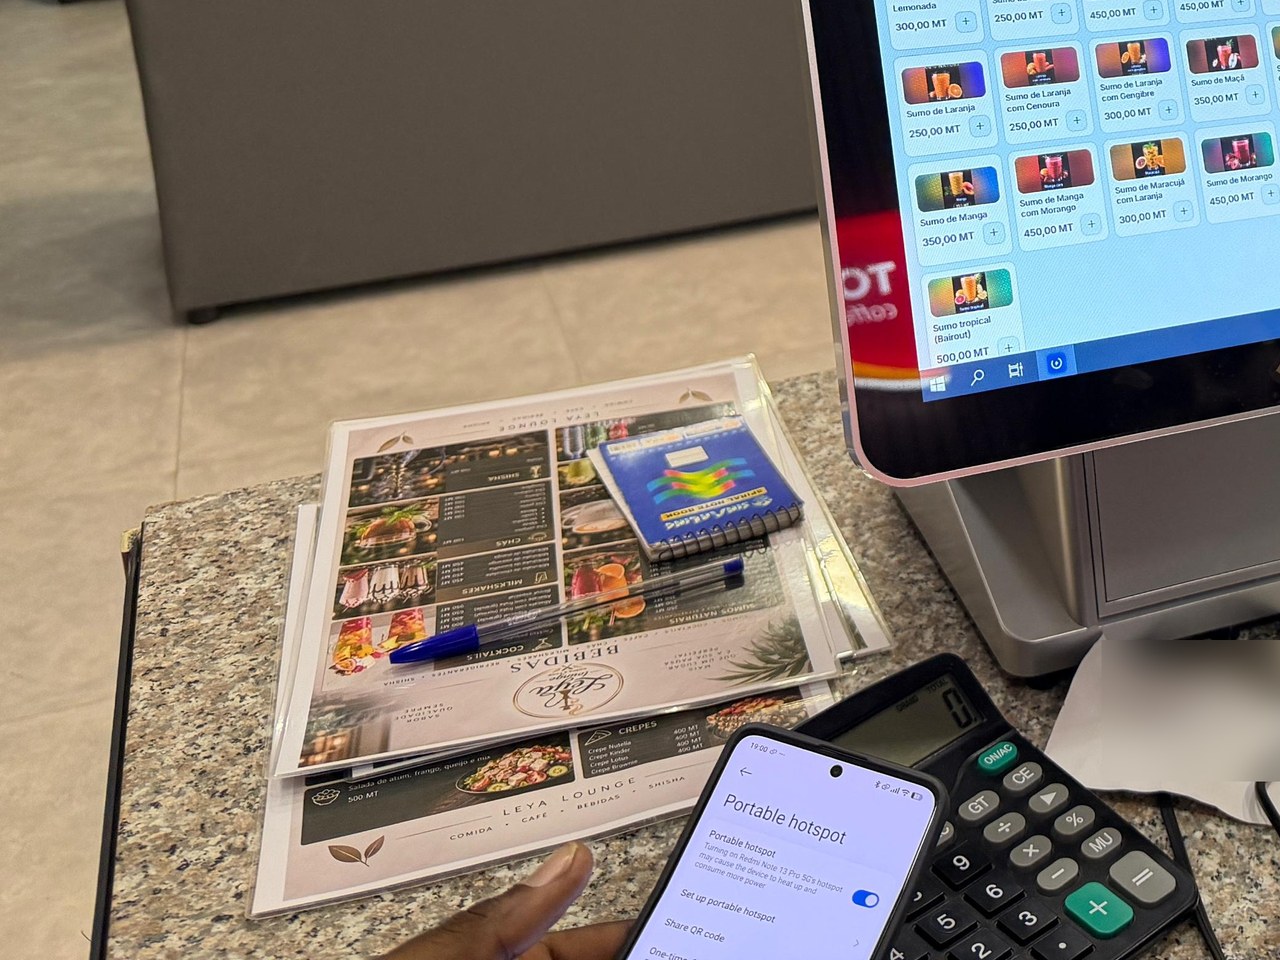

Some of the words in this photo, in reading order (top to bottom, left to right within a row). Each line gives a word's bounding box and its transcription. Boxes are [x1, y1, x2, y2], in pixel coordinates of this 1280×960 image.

[893, 2, 937, 12] Lemonada
[1180, 2, 1209, 11] 450,00
[1211, 0, 1224, 8] MT
[994, 13, 1027, 23] 250,00
[1029, 11, 1043, 20] MT
[896, 21, 930, 32] 300,00
[932, 19, 947, 28] MT
[1191, 79, 1213, 87] Sumo
[1225, 74, 1245, 84] Maçã
[1194, 95, 1224, 106] 350,00
[1225, 93, 1239, 101] MT
[1115, 185, 1138, 194] Sumo
[1149, 178, 1185, 190] Maracujá
[1116, 196, 1134, 204] com
[1134, 192, 1163, 202] Laranja
[1119, 212, 1151, 224] 300,00
[1152, 210, 1167, 220] MT
[933, 322, 957, 332] Sumo
[960, 316, 991, 330] tropical
[934, 330, 971, 344] (Bairout)
[936, 350, 972, 364] 500,00
[973, 347, 989, 357] MT
[462, 579, 522, 594] MILKSHAKES
[669, 611, 717, 624] NATURAIS
[466, 644, 524, 660] COCKTAILS
[510, 645, 618, 673] BEBIDAS
[529, 674, 613, 696] Leya
[619, 721, 658, 735] CREPES
[750, 742, 768, 753] 19:00
[984, 743, 1013, 765] ON/AC
[648, 776, 685, 789] SHISHA
[1012, 768, 1035, 784] CE
[348, 794, 363, 803] 500
[365, 791, 379, 800] MT
[503, 799, 548, 816] LEYA
[562, 776, 637, 802] LOUNGE
[968, 797, 990, 814] GT
[450, 826, 493, 840] COMIDA
[577, 794, 621, 810] BEBIDAS
[723, 794, 786, 825] Portable
[788, 814, 846, 845] hotspot
[709, 830, 743, 847] Portable
[744, 841, 776, 858] hotspot
[1089, 833, 1113, 852] MU
[704, 842, 728, 858] Turning
[739, 853, 760, 866] Redmi
[762, 861, 777, 871] Note
[789, 869, 801, 879] Pro
[817, 878, 843, 893] hotspot
[953, 855, 969, 869] 9
[985, 884, 1003, 898] 6
[680, 889, 694, 898] Set
[695, 893, 706, 903] up
[708, 897, 742, 914] portable
[743, 907, 775, 923] hotspot
[937, 914, 956, 930] 5
[1019, 911, 1038, 925] 3
[664, 918, 689, 932] Share
[690, 926, 703, 936] QR
[704, 930, 725, 942] code
